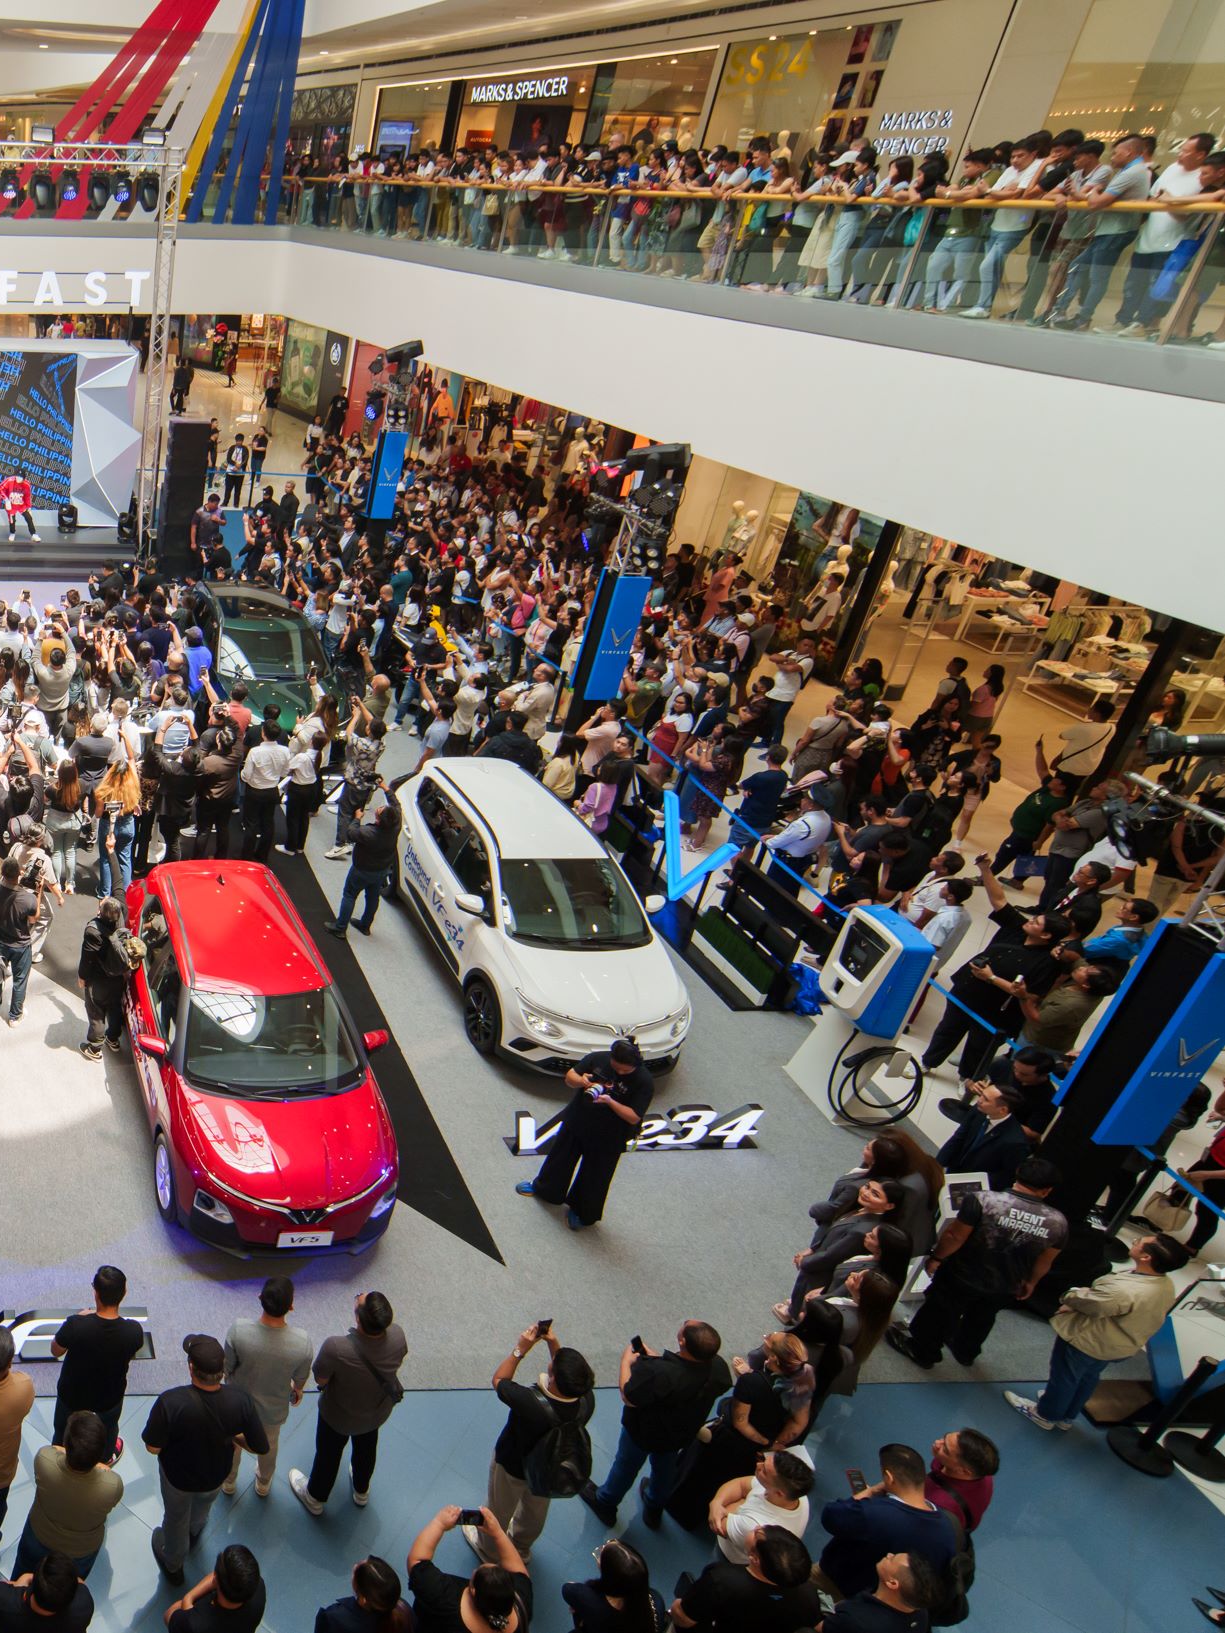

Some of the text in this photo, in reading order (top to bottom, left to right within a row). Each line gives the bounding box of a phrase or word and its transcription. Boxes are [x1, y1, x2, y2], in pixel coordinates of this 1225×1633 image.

[471, 81, 506, 103] MARKS
[515, 76, 569, 100] SPENCER
[879, 108, 953, 131] MARKS &
[872, 136, 950, 156] SPENCER
[9, 407, 36, 428] HELLO
[404, 854, 428, 898] Comfort
[407, 843, 431, 886] Unbound
[998, 1216, 1050, 1239] MARSHAL
[1009, 1208, 1046, 1227] EVENT
